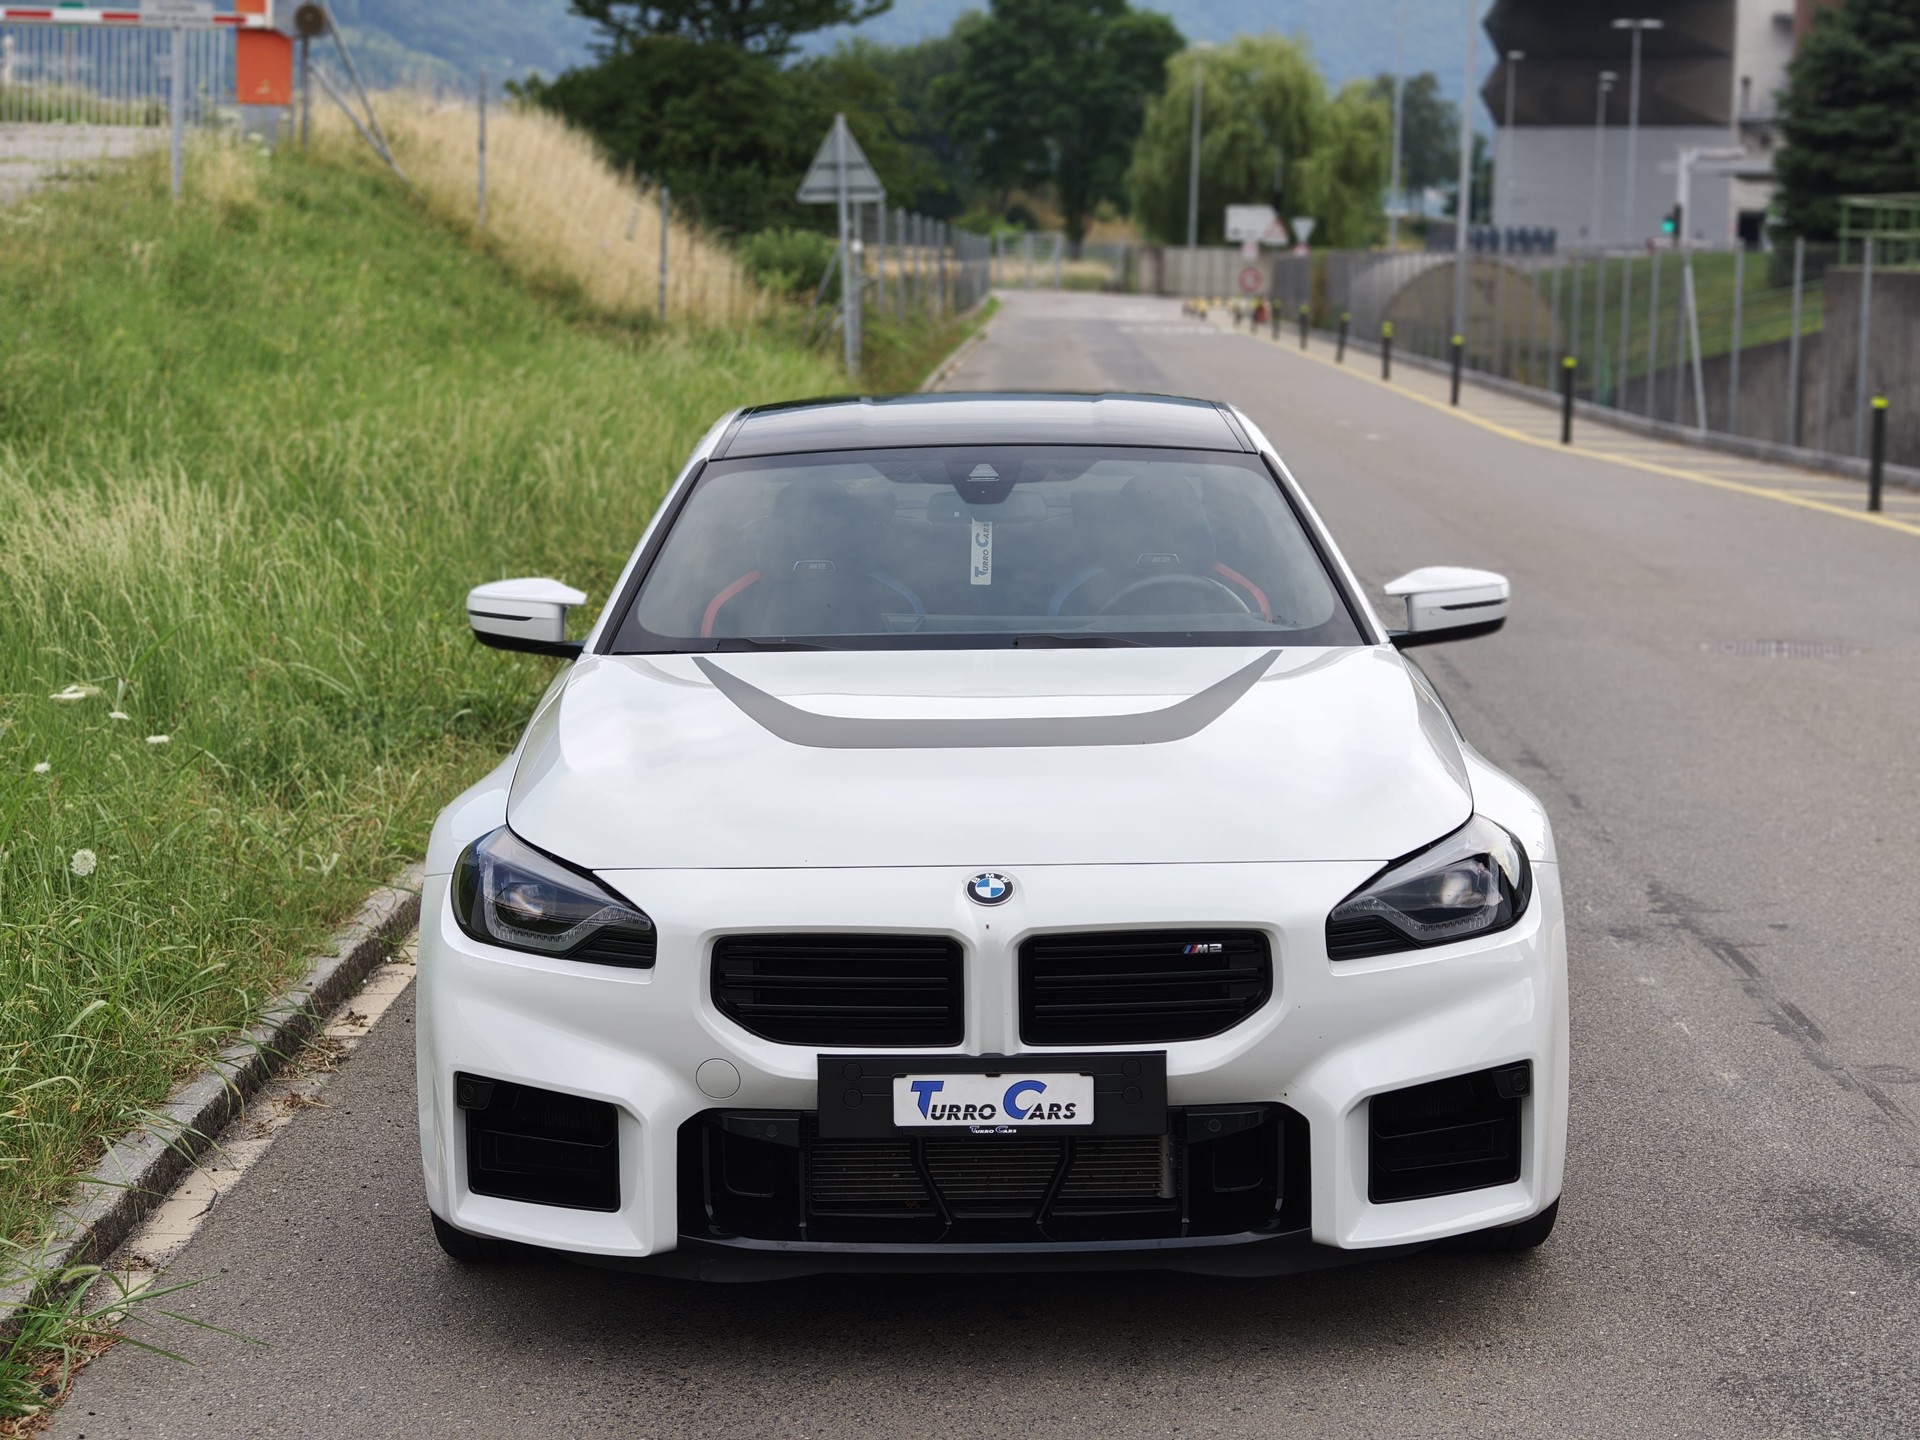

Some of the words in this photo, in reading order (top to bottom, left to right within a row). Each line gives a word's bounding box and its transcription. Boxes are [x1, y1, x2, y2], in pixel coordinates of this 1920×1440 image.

[975, 522, 990, 547] CARS
[974, 549, 989, 577] TURRO
[970, 873, 1010, 883] BMW
[910, 1080, 997, 1121] TURRO
[1003, 1079, 1077, 1120] CARS
[969, 1125, 995, 1134] TURRO
[995, 1125, 1018, 1134] CARS
